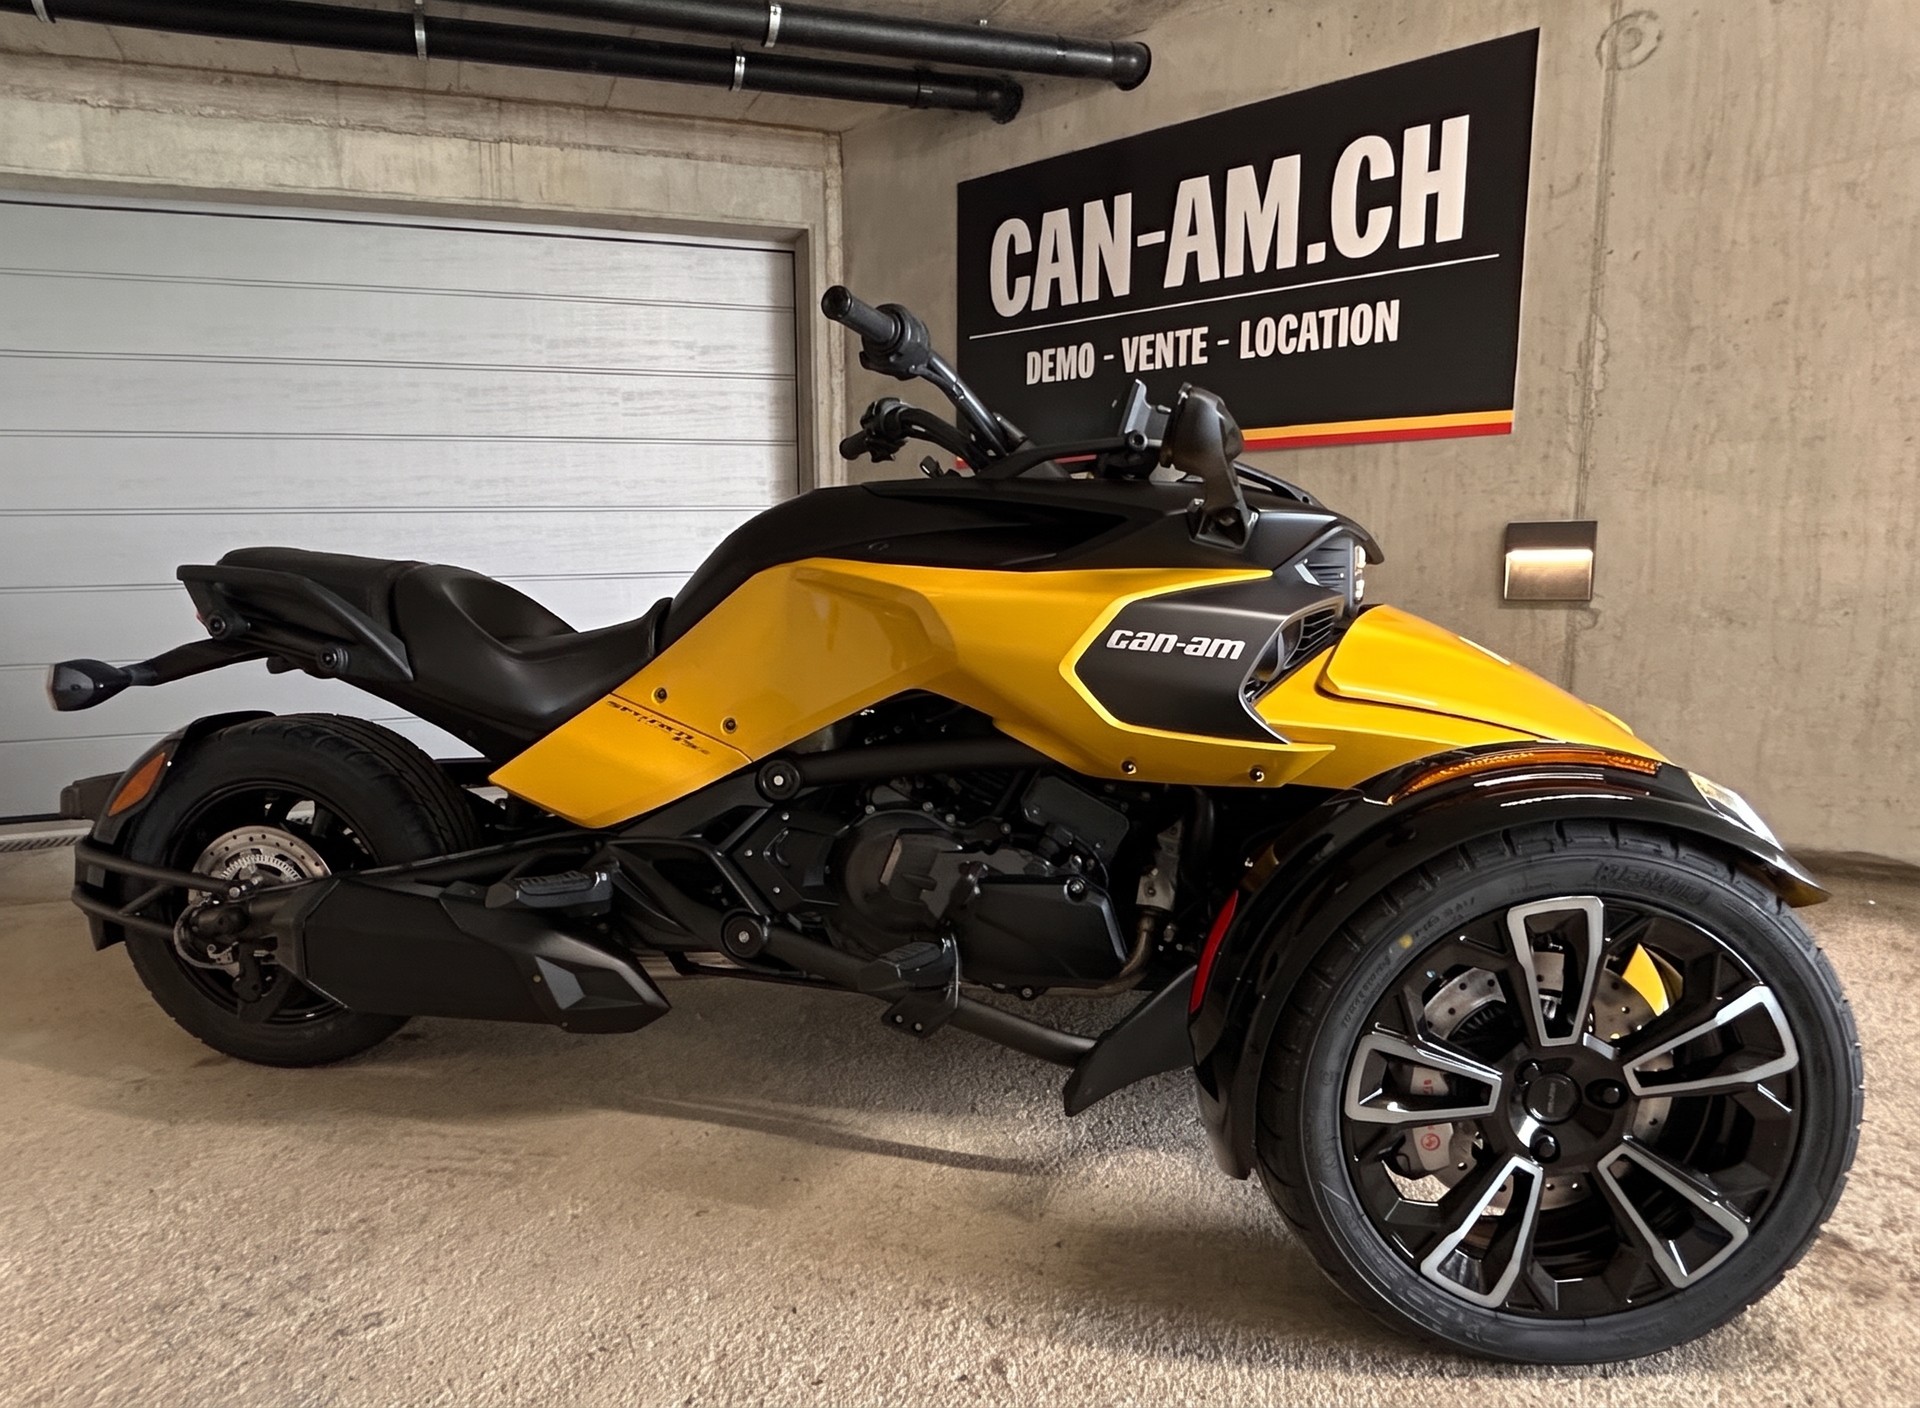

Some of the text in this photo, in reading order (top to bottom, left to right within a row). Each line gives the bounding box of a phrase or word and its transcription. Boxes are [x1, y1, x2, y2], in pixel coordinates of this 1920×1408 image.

[990, 115, 1470, 318] CAN-AM.CH
[1026, 342, 1095, 385] DEMO
[1121, 326, 1209, 373] VENTE
[1239, 299, 1400, 360] LOCATION
[1106, 629, 1246, 660] can-am
